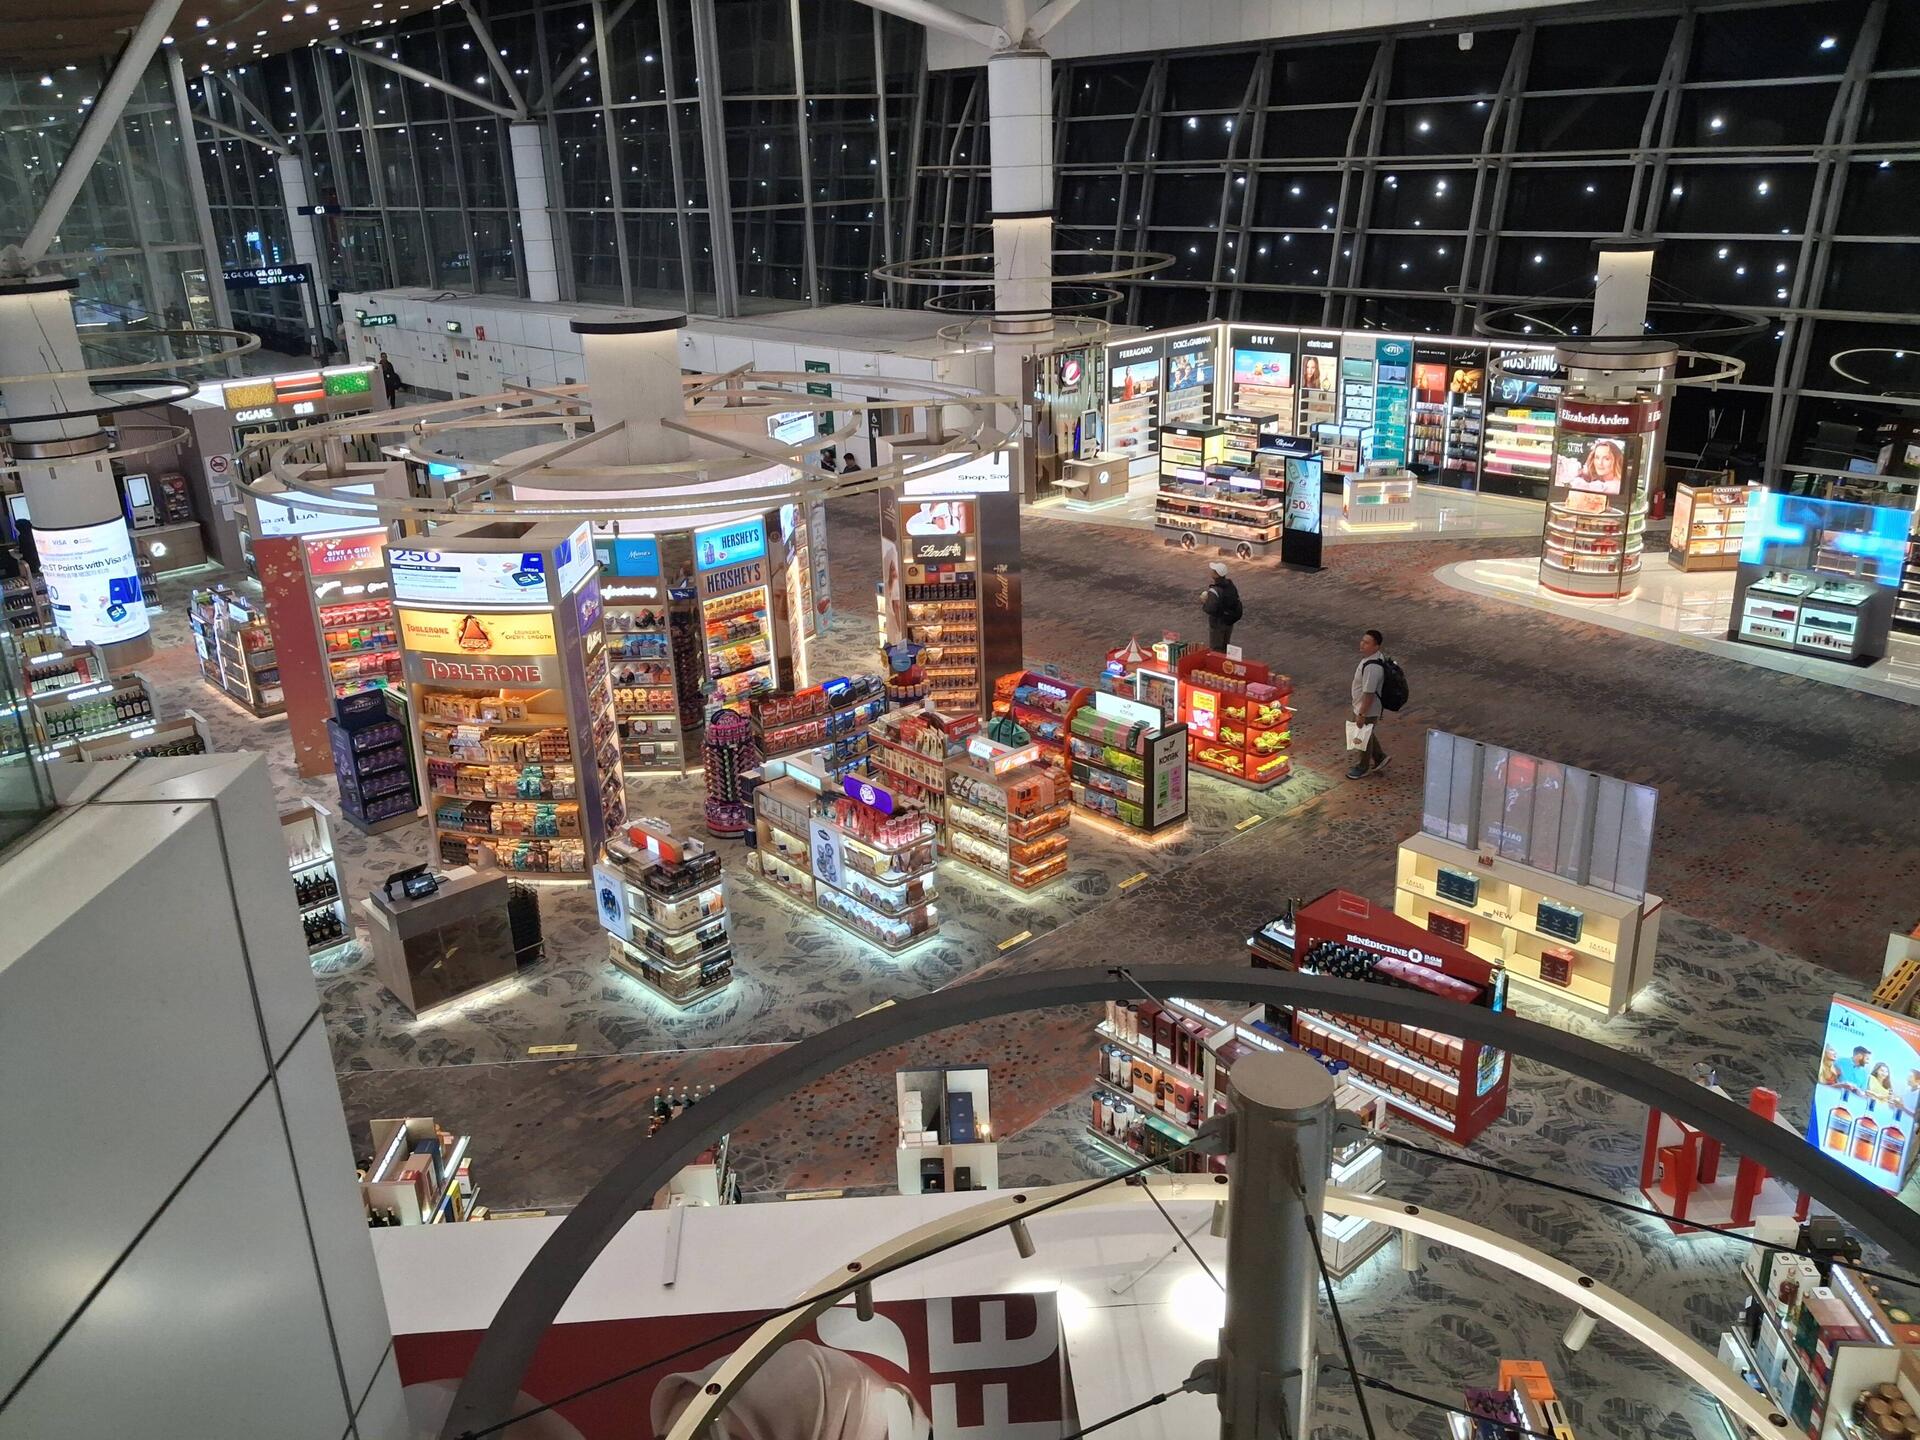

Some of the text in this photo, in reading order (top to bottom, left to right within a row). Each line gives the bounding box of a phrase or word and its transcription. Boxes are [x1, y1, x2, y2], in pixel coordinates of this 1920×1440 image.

[1251, 336, 1275, 345] DKNY
[1119, 346, 1154, 359] FERRAGAMO
[236, 408, 273, 422] CIGARS
[1562, 409, 1630, 425] Elizabeth Arden
[721, 528, 760, 549] HERSHEY'S
[58, 563, 84, 572] Points
[85, 560, 104, 570] with
[104, 556, 122, 566] Visa
[706, 563, 762, 593] HERSHEY'S
[422, 658, 542, 683] TOBLERONE
[1492, 909, 1513, 921] NEW
[1346, 934, 1408, 957] BÉNÉDICTINE
